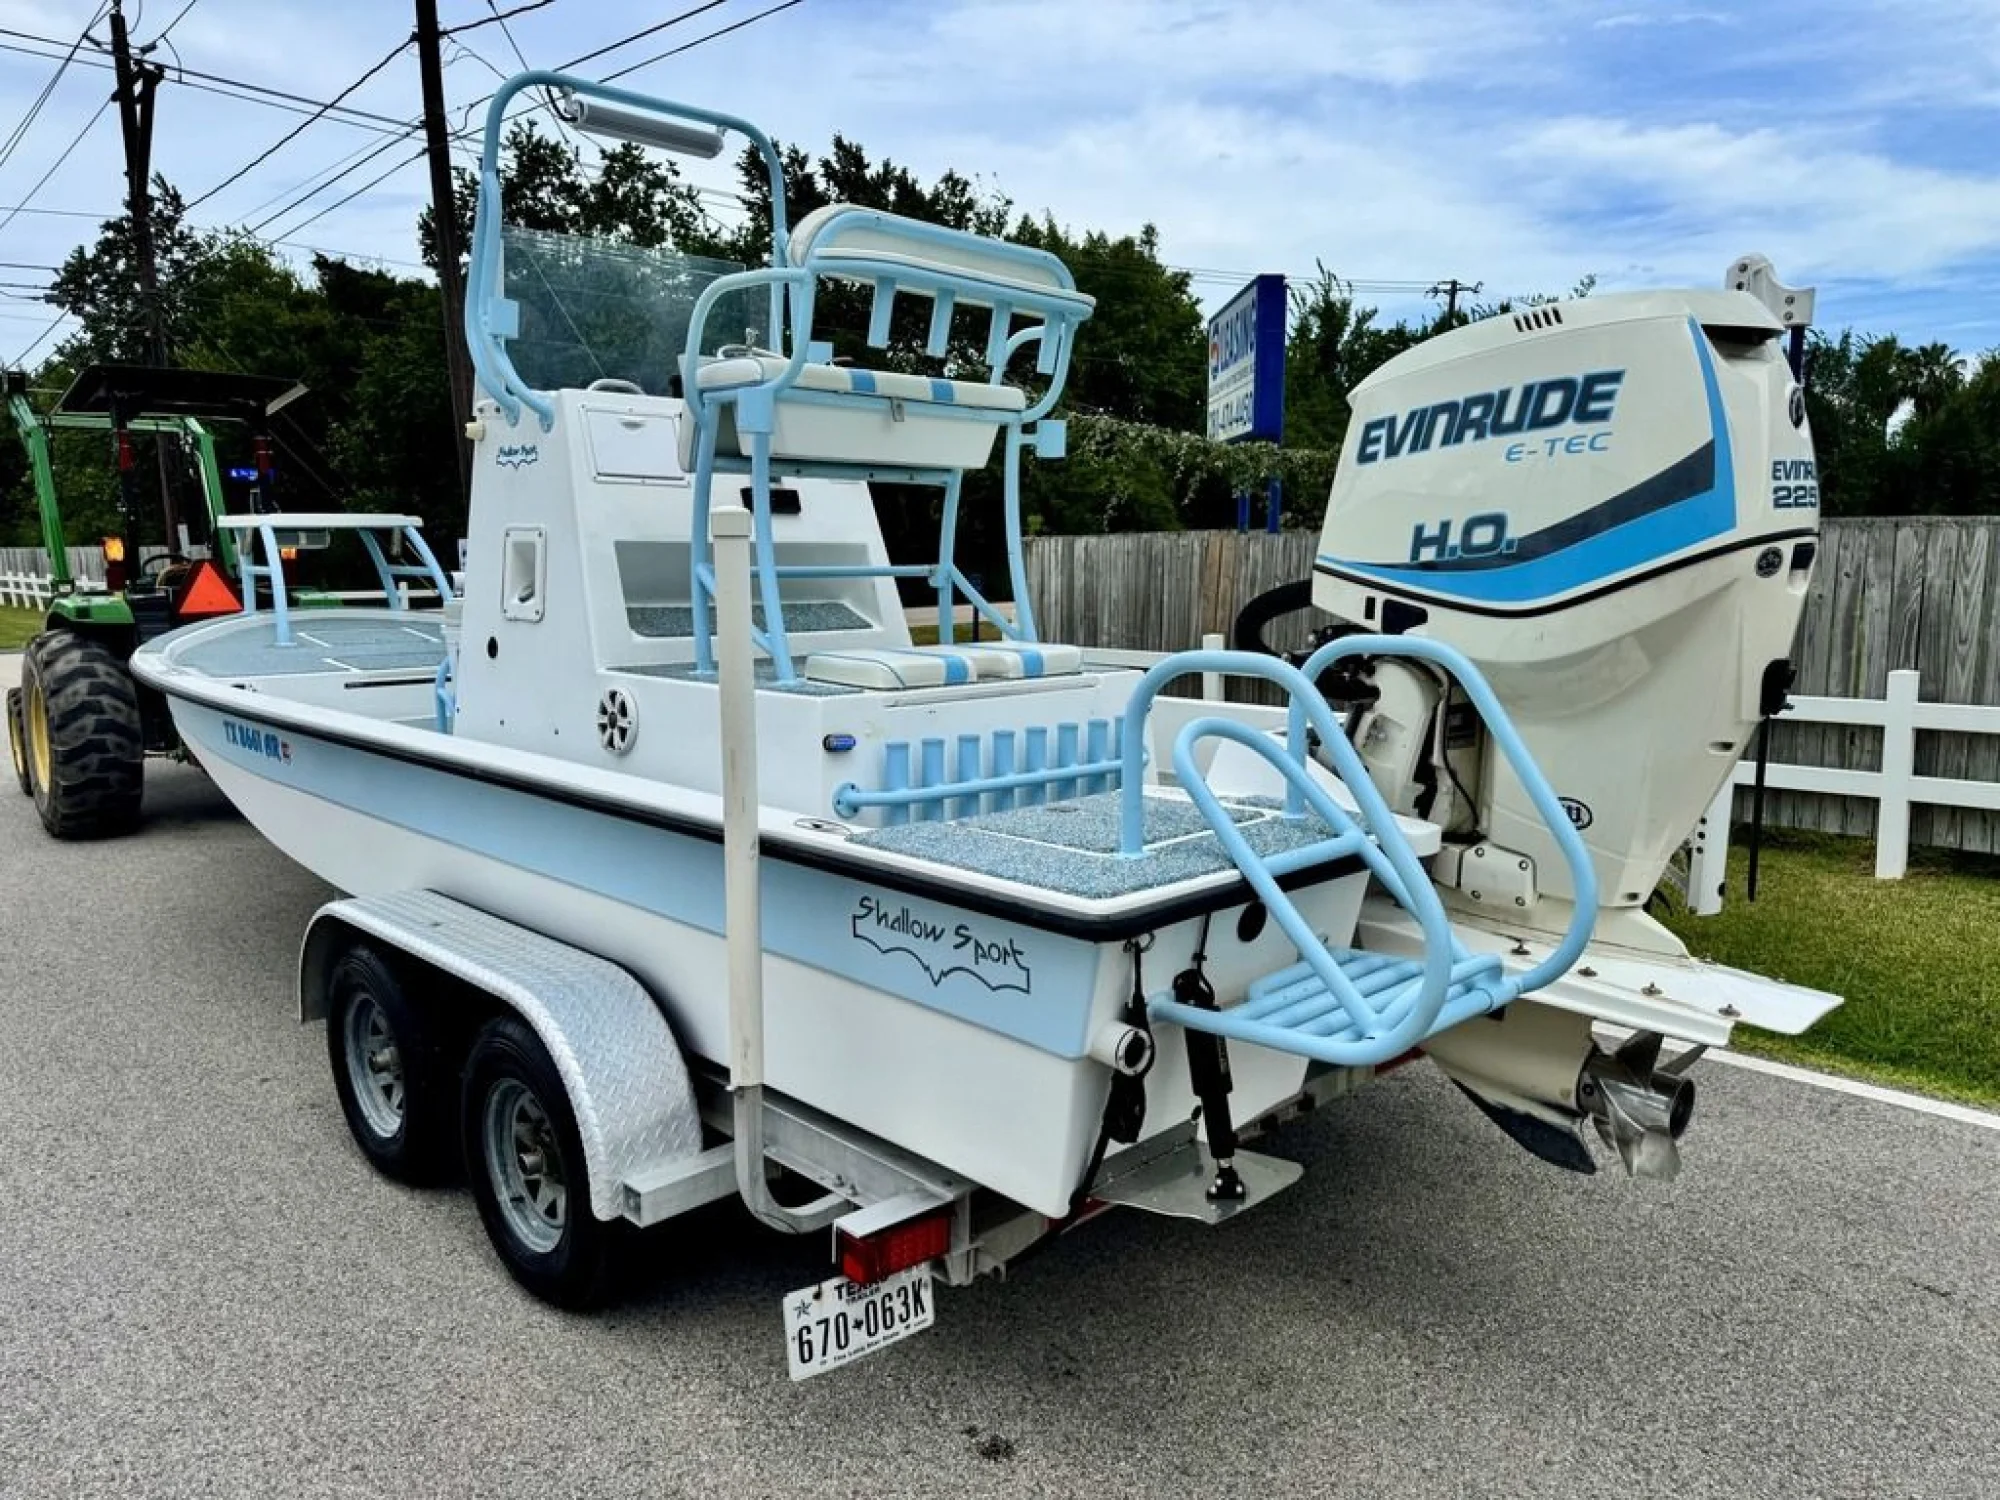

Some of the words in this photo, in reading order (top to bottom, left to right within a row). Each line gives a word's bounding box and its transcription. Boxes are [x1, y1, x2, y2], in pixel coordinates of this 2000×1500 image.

[1356, 369, 1627, 466] EVINRUDE
[1504, 431, 1614, 463] E-TEC
[1772, 485, 1818, 510] 225
[1409, 511, 1519, 563] H.O.
[857, 895, 946, 943] Shallow
[952, 923, 1026, 966] Sport
